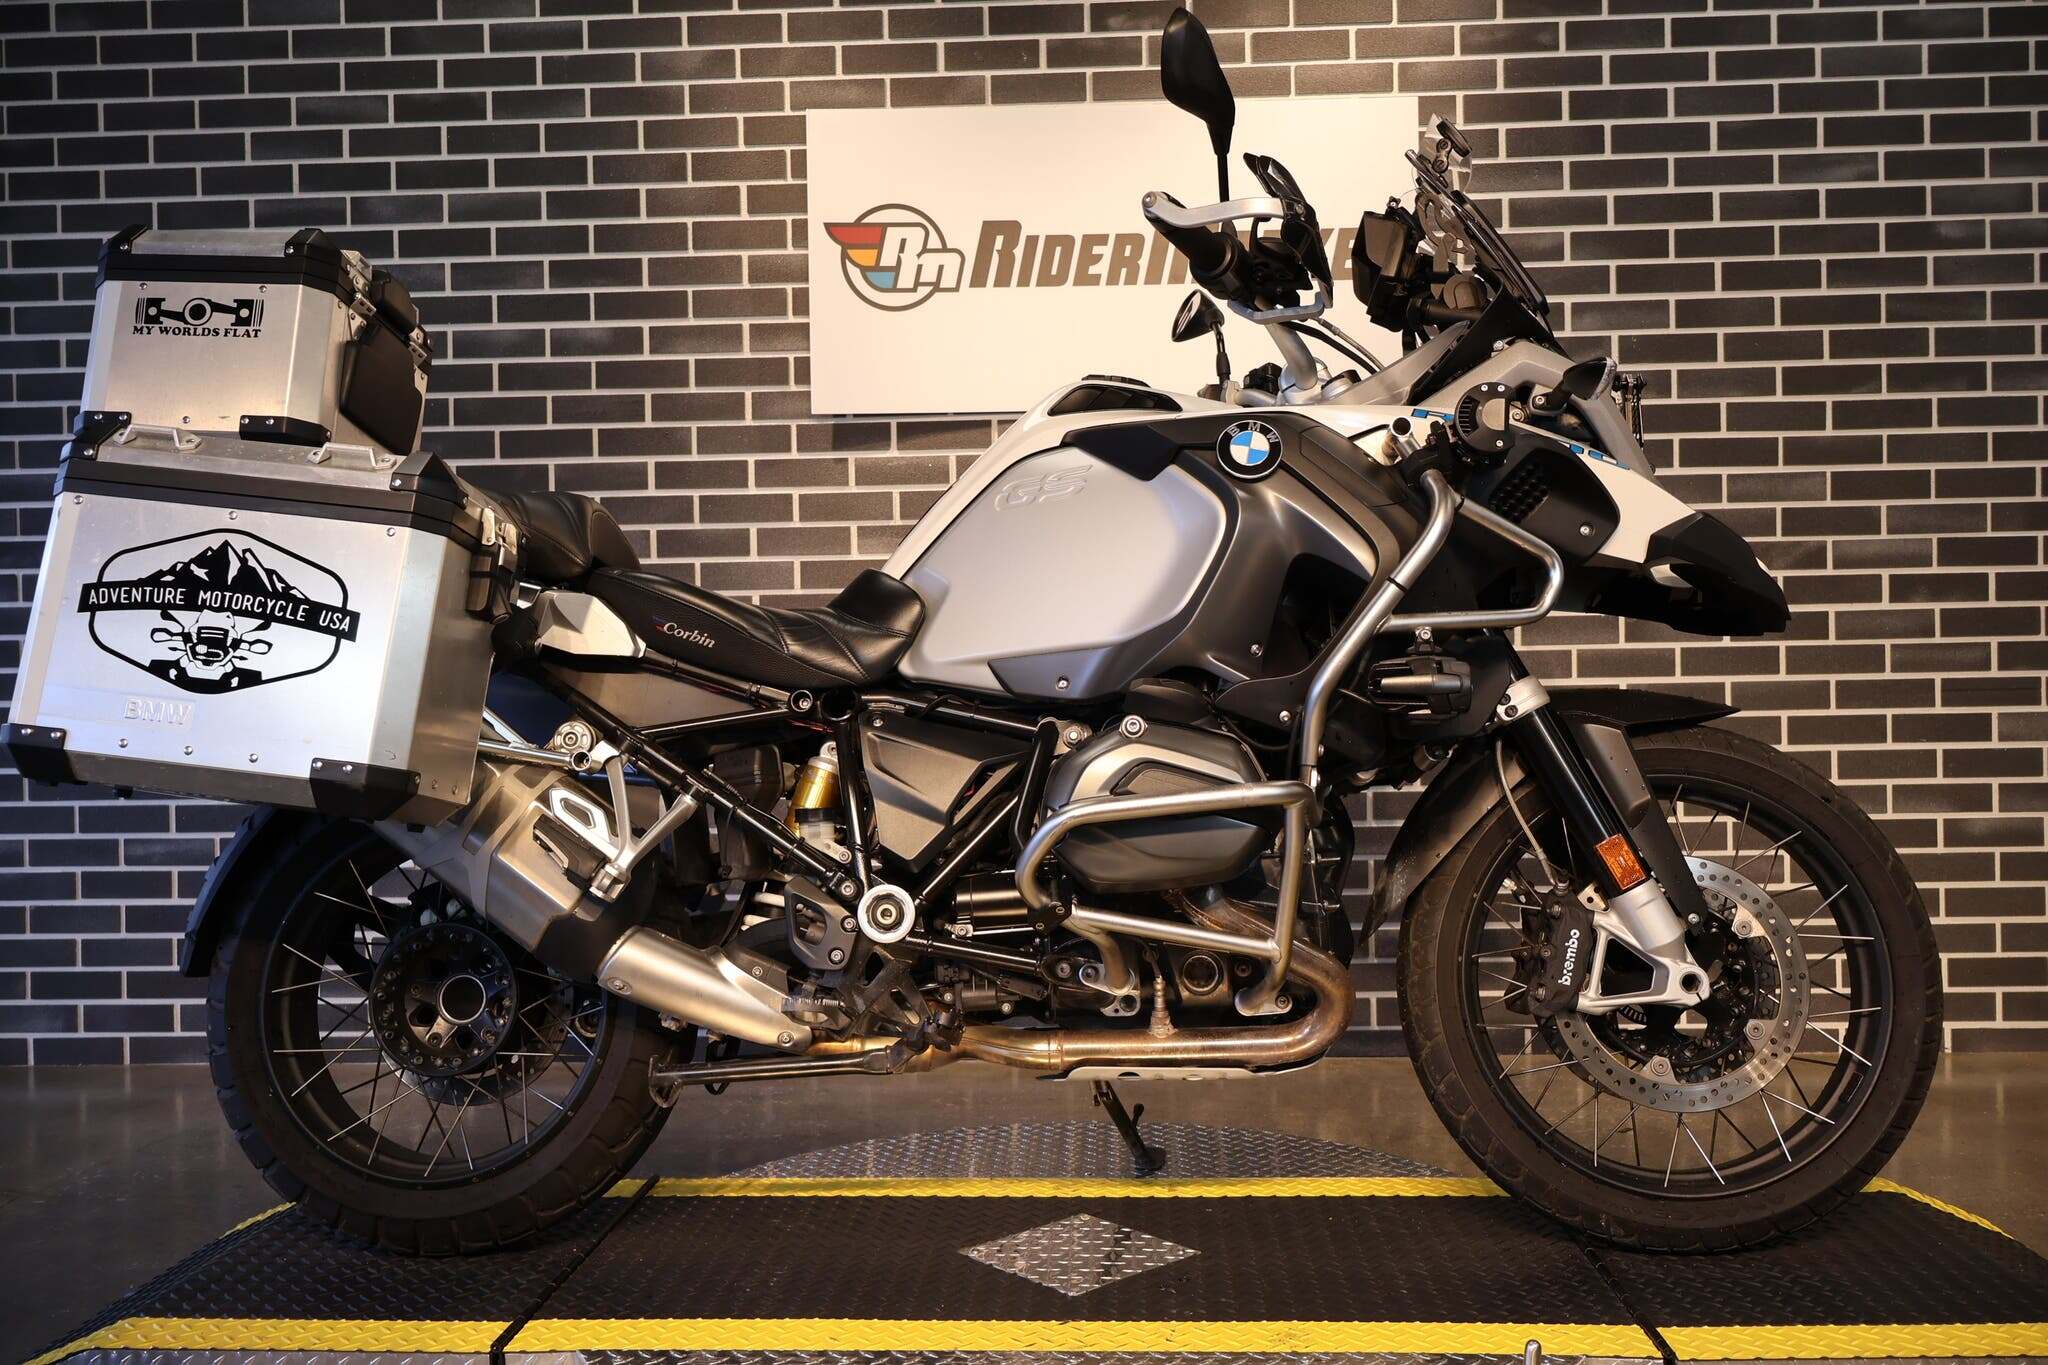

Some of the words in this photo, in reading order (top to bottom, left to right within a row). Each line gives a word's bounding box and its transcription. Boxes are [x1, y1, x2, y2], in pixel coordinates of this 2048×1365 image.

[132, 325, 154, 335] MY
[158, 325, 220, 337] WORLDS
[223, 328, 262, 338] FLAT
[88, 586, 187, 606] ADVENTURE
[198, 589, 308, 622] MOTORCYCLE
[318, 609, 351, 633] USA
[663, 622, 716, 649] Corbin
[123, 697, 193, 726] BMW
[1557, 928, 1580, 986] brembo
